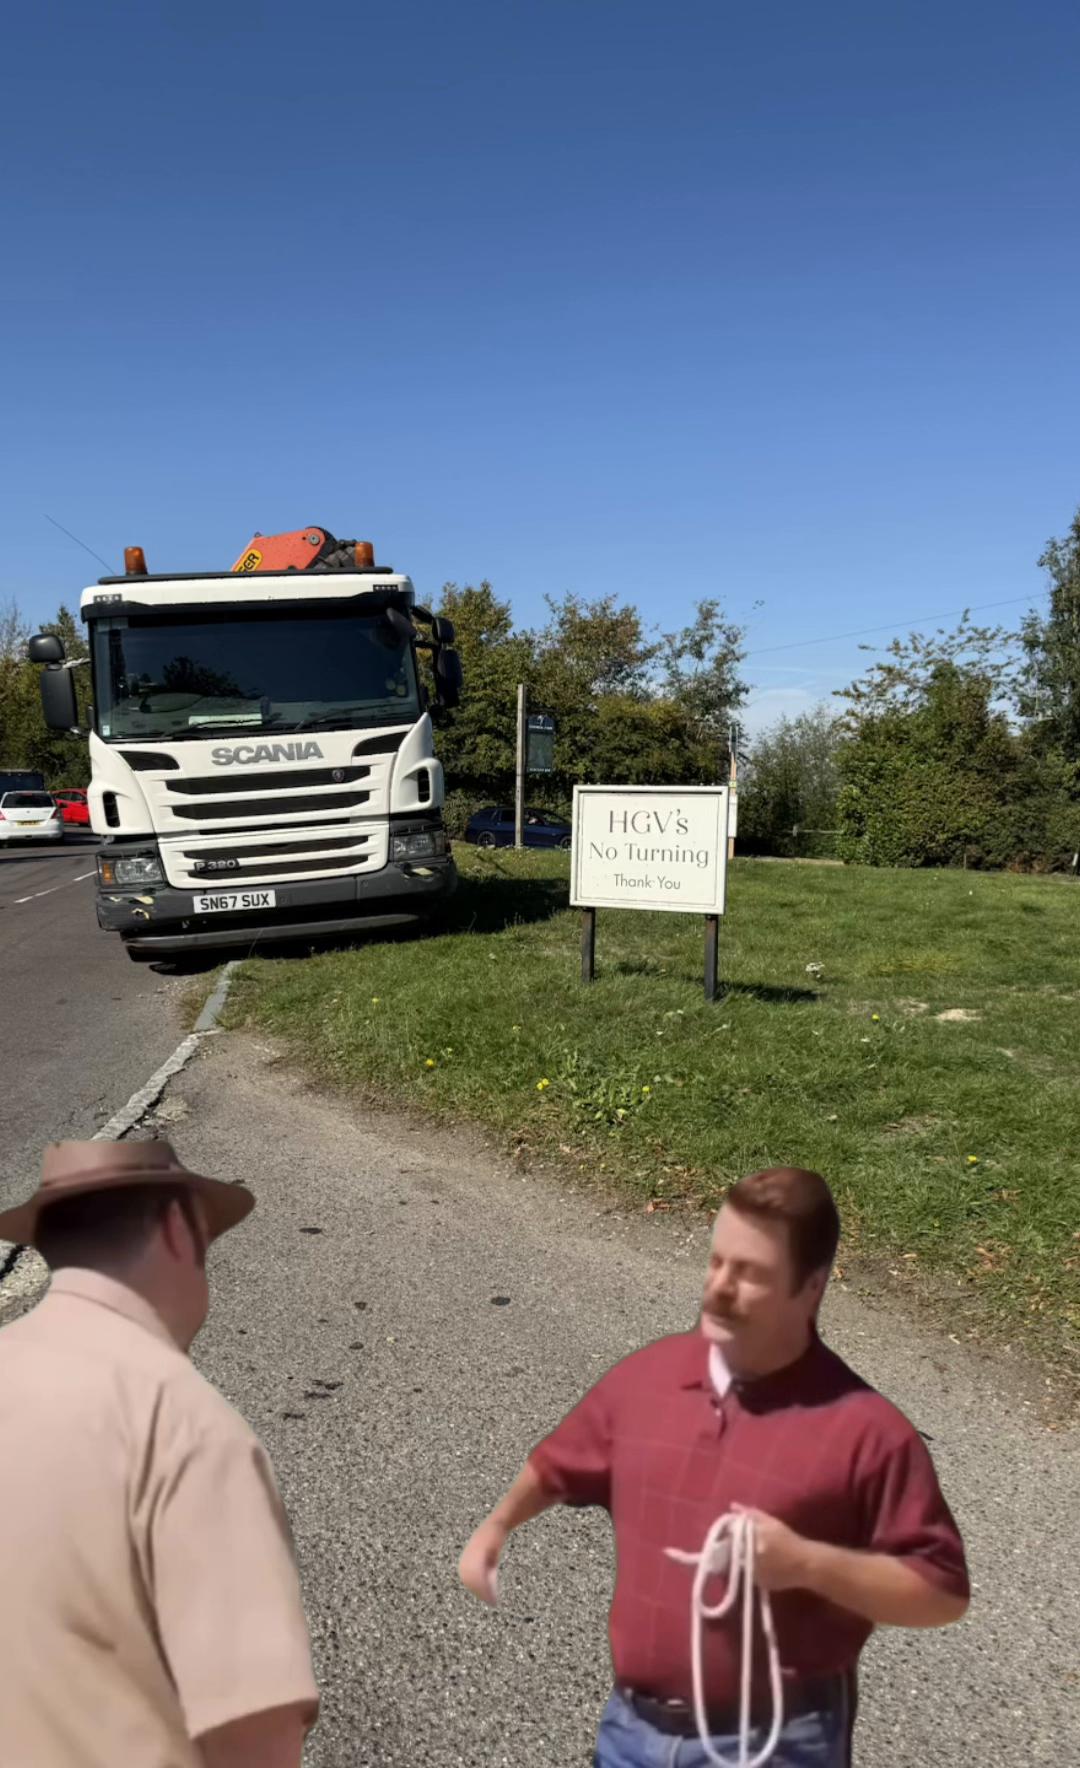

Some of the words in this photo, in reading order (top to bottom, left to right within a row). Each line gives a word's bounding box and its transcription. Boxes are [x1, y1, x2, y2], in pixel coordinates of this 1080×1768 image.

[211, 741, 324, 766] SCANIA
[609, 808, 689, 835] HGV's
[589, 841, 618, 860] No
[624, 843, 709, 869] Turning
[613, 872, 652, 889] Thank
[657, 876, 681, 890] You
[200, 895, 238, 911] SN67
[241, 893, 270, 908] SUX
